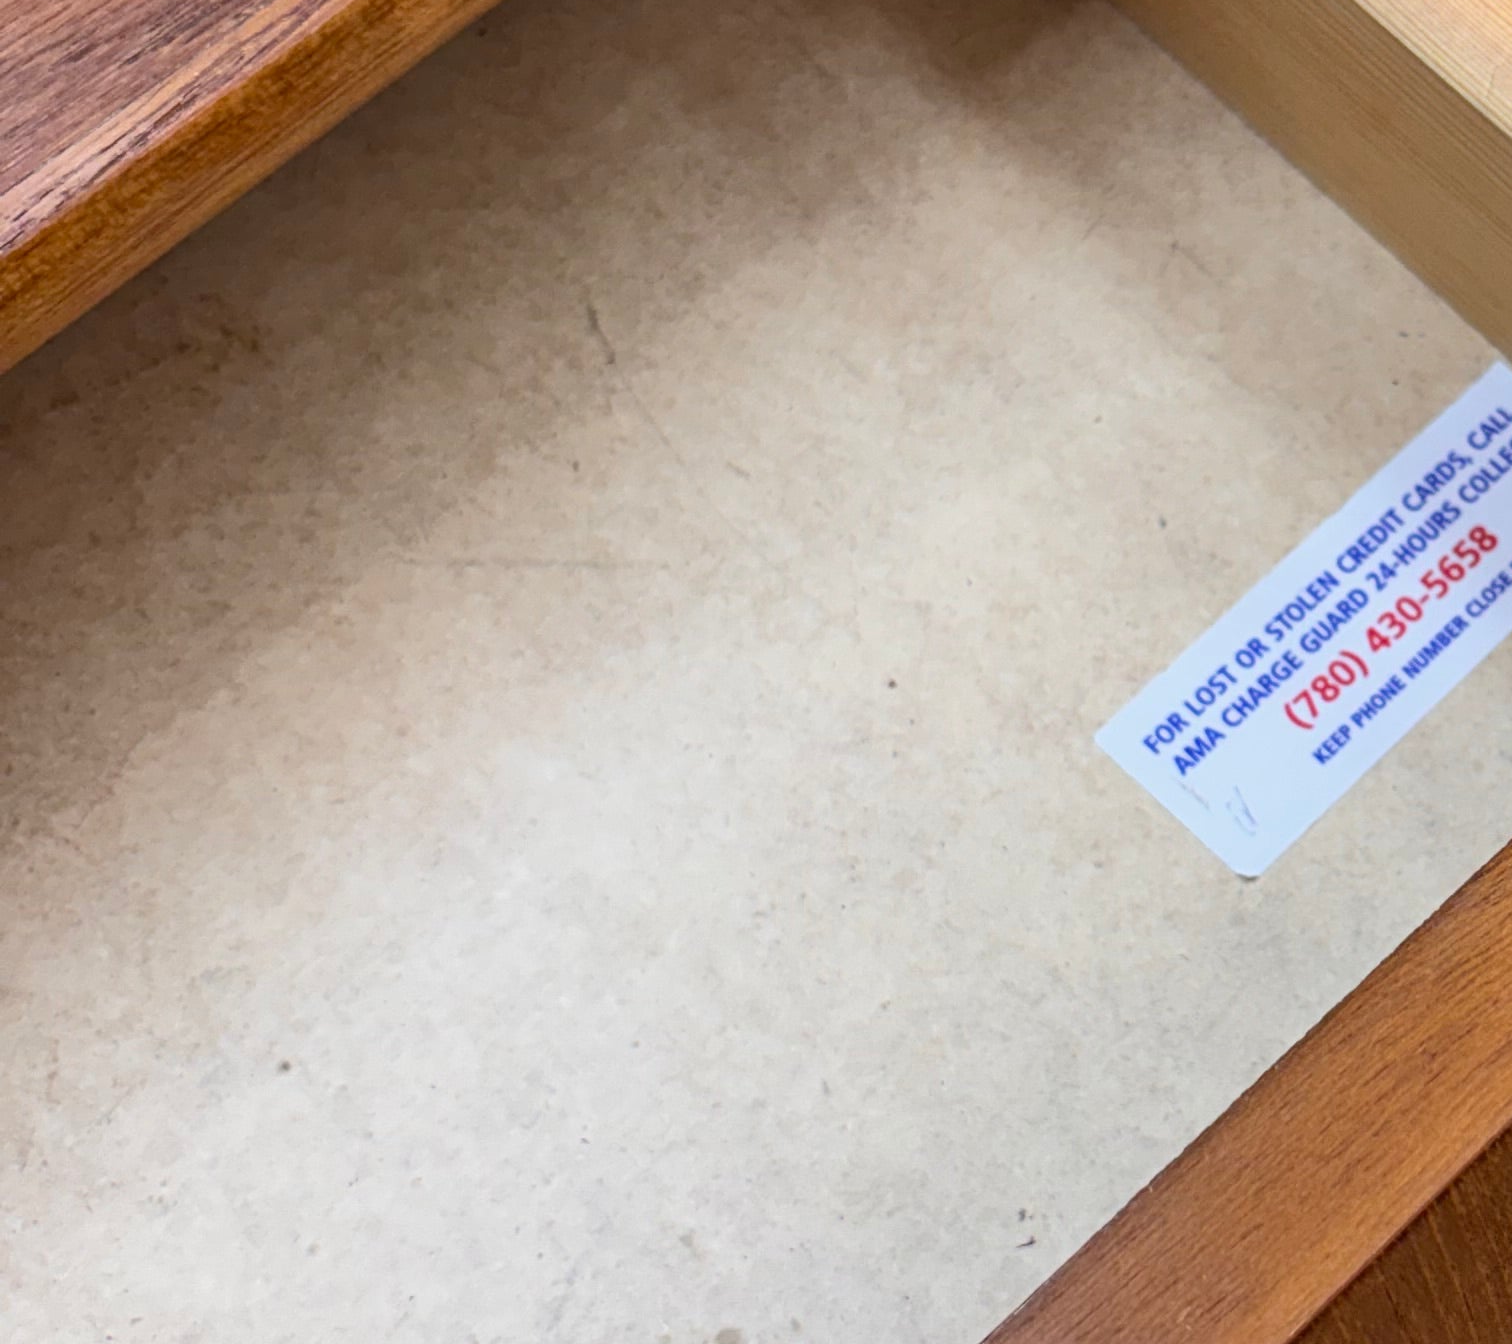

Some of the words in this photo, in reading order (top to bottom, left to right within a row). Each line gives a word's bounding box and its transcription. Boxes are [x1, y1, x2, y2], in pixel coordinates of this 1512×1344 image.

[1143, 712, 1190, 755] FOR
[1183, 665, 1238, 717] LOST
[1234, 637, 1270, 669] OR
[1264, 570, 1340, 642] STOLEN
[1336, 507, 1405, 574] CREDIT
[1401, 451, 1473, 512] CARDS,
[1173, 726, 1226, 776] AMA
[1221, 650, 1304, 727] CHARGE
[1299, 588, 1369, 654] GUARD
[1365, 500, 1462, 592] 24-HOURS
[1283, 649, 1370, 730] (780)
[1365, 525, 1499, 653] 430-5658
[1312, 724, 1351, 765] KEEP
[1350, 674, 1407, 728] PHONE
[1401, 615, 1470, 679] NUMBER
